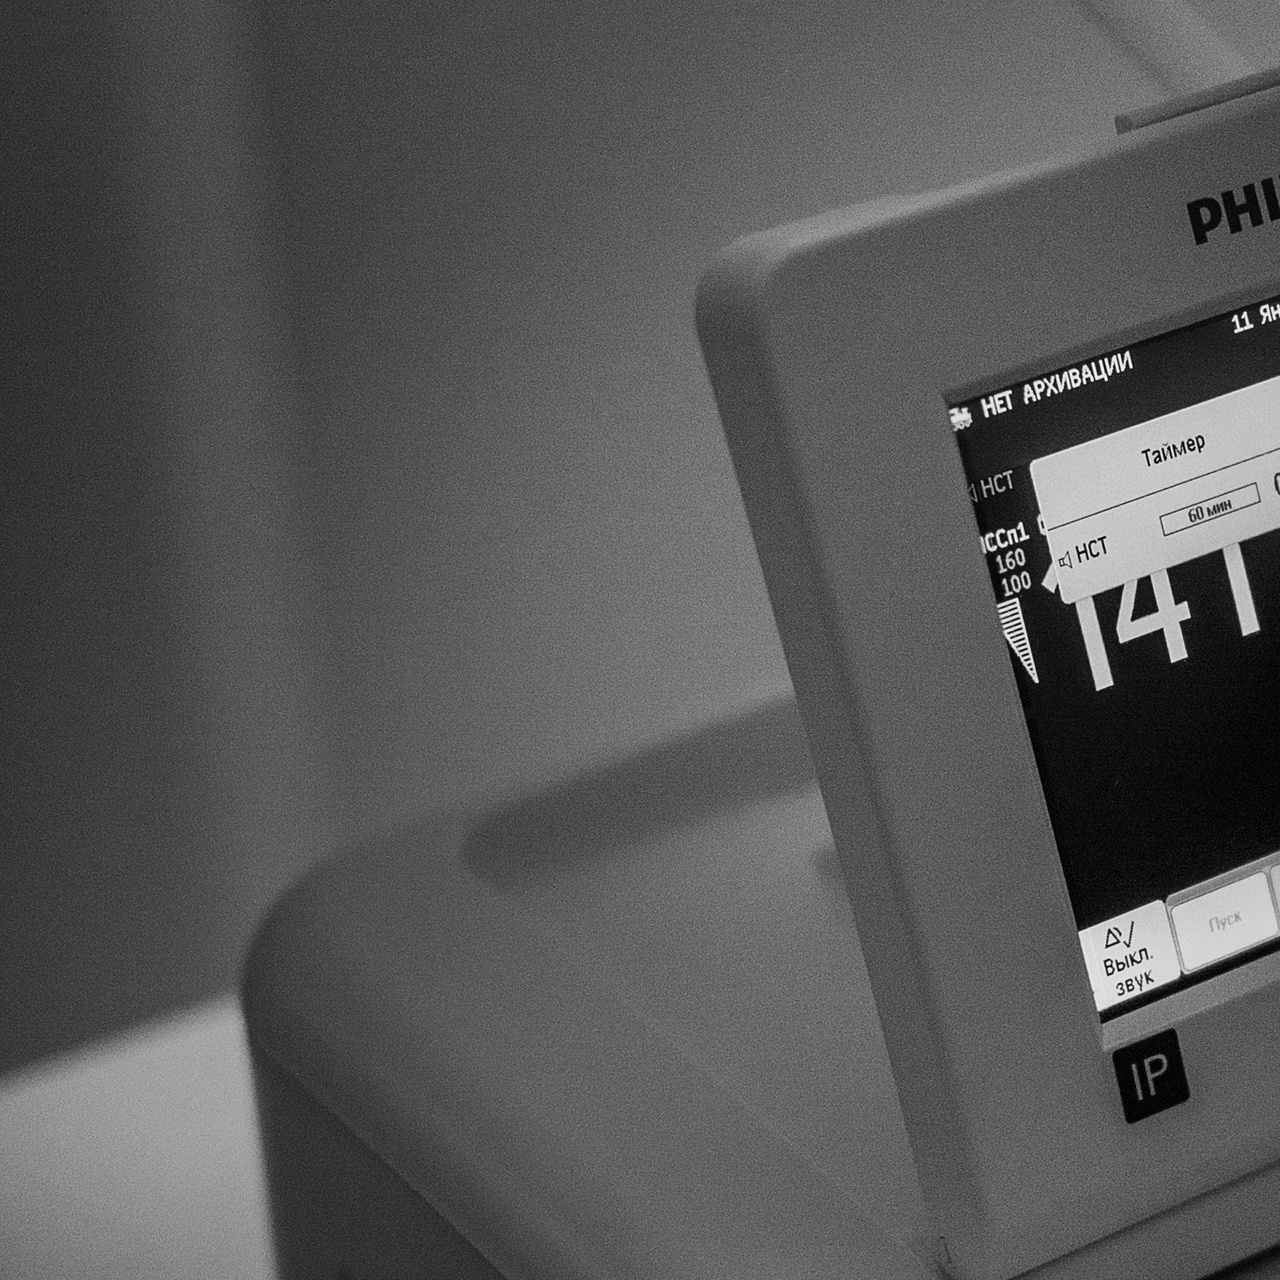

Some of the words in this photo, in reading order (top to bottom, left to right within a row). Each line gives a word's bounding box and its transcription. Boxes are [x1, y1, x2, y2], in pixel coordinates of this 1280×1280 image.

[1231, 311, 1254, 334] 11
[980, 390, 1013, 418] НЕТ
[1023, 350, 1133, 405] АРХИВАЦИИ
[1141, 434, 1206, 467] Таймер
[980, 470, 1014, 499] НСТ
[1188, 505, 1204, 524] 60
[1206, 499, 1233, 519] мин
[995, 548, 1027, 574] 160
[1075, 536, 1108, 564] НСТ
[1001, 571, 1032, 597] 100
[1207, 908, 1244, 936] Пуск
[1102, 945, 1154, 978] Выкл.
[1115, 967, 1156, 998] звук
[1130, 1053, 1169, 1102] IP
